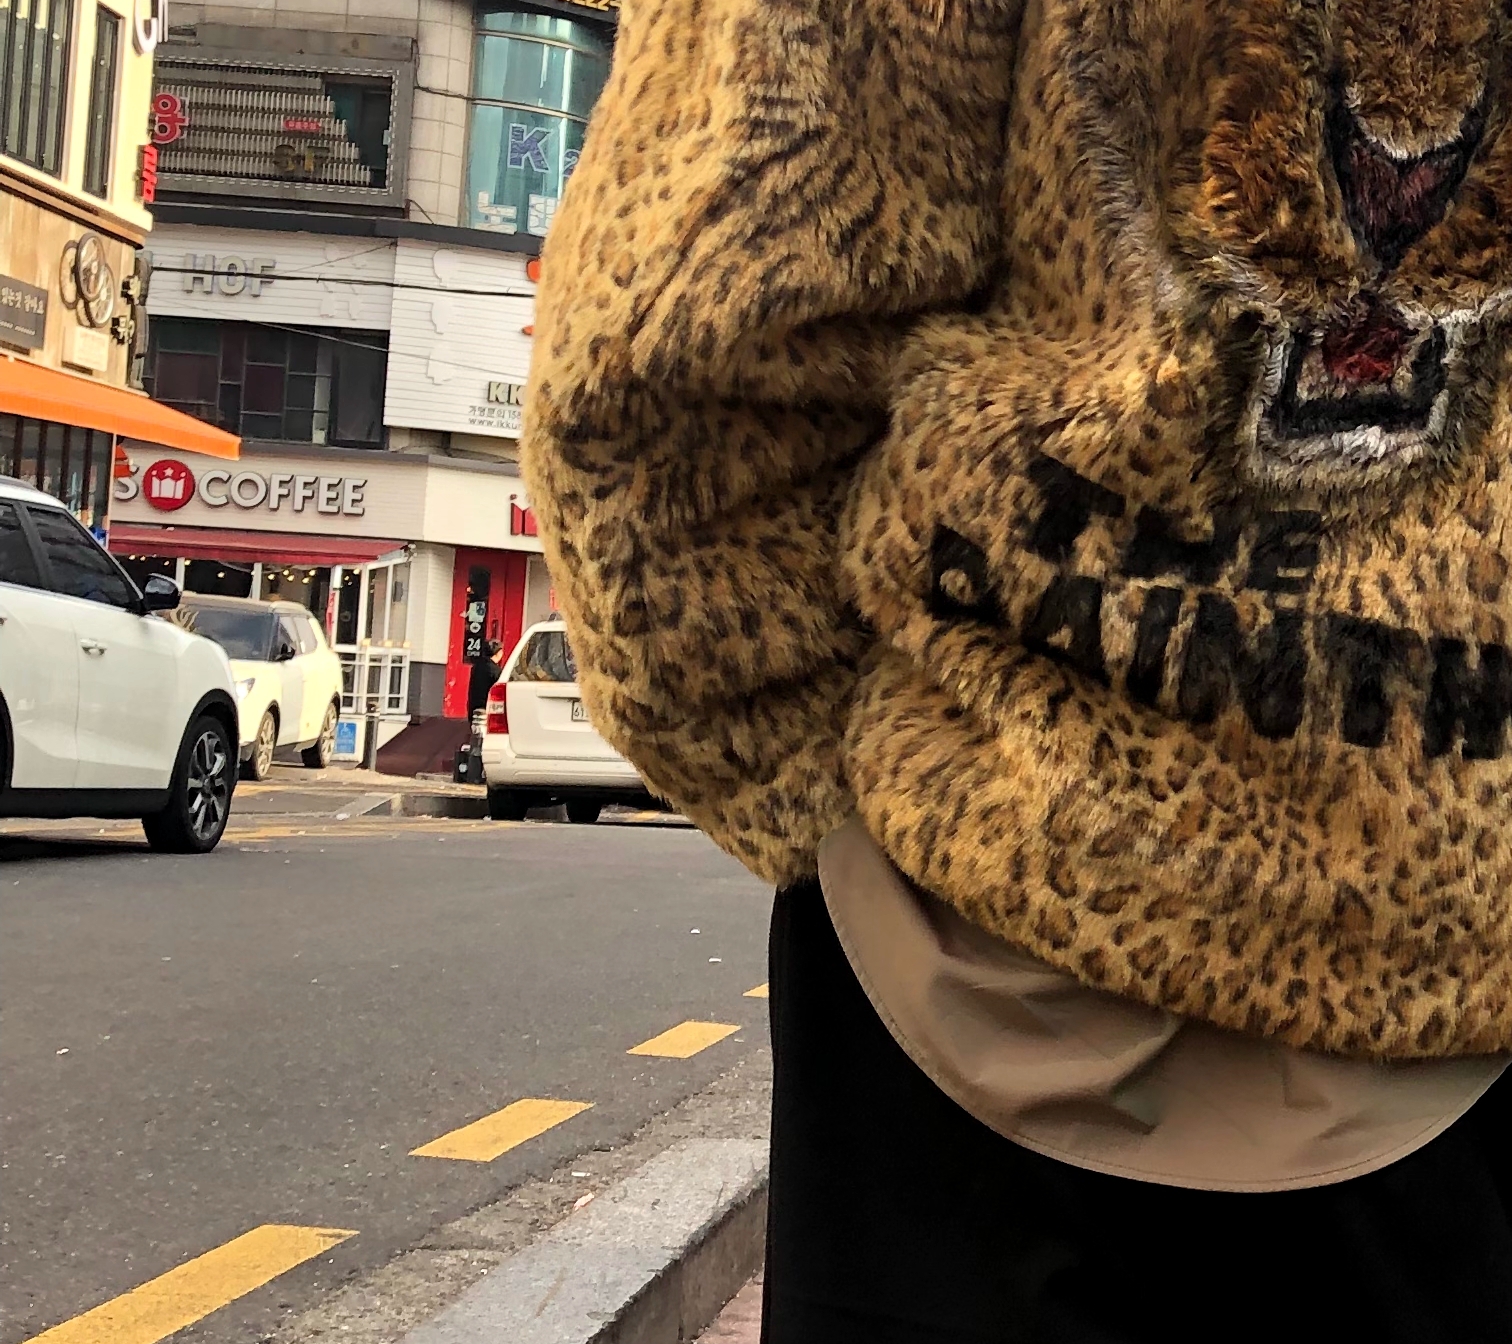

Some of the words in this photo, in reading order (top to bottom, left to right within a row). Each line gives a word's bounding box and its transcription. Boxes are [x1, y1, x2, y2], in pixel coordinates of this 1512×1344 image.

[183, 254, 277, 297] HOF
[200, 470, 368, 517] COFFEE
[467, 638, 481, 651] 24
